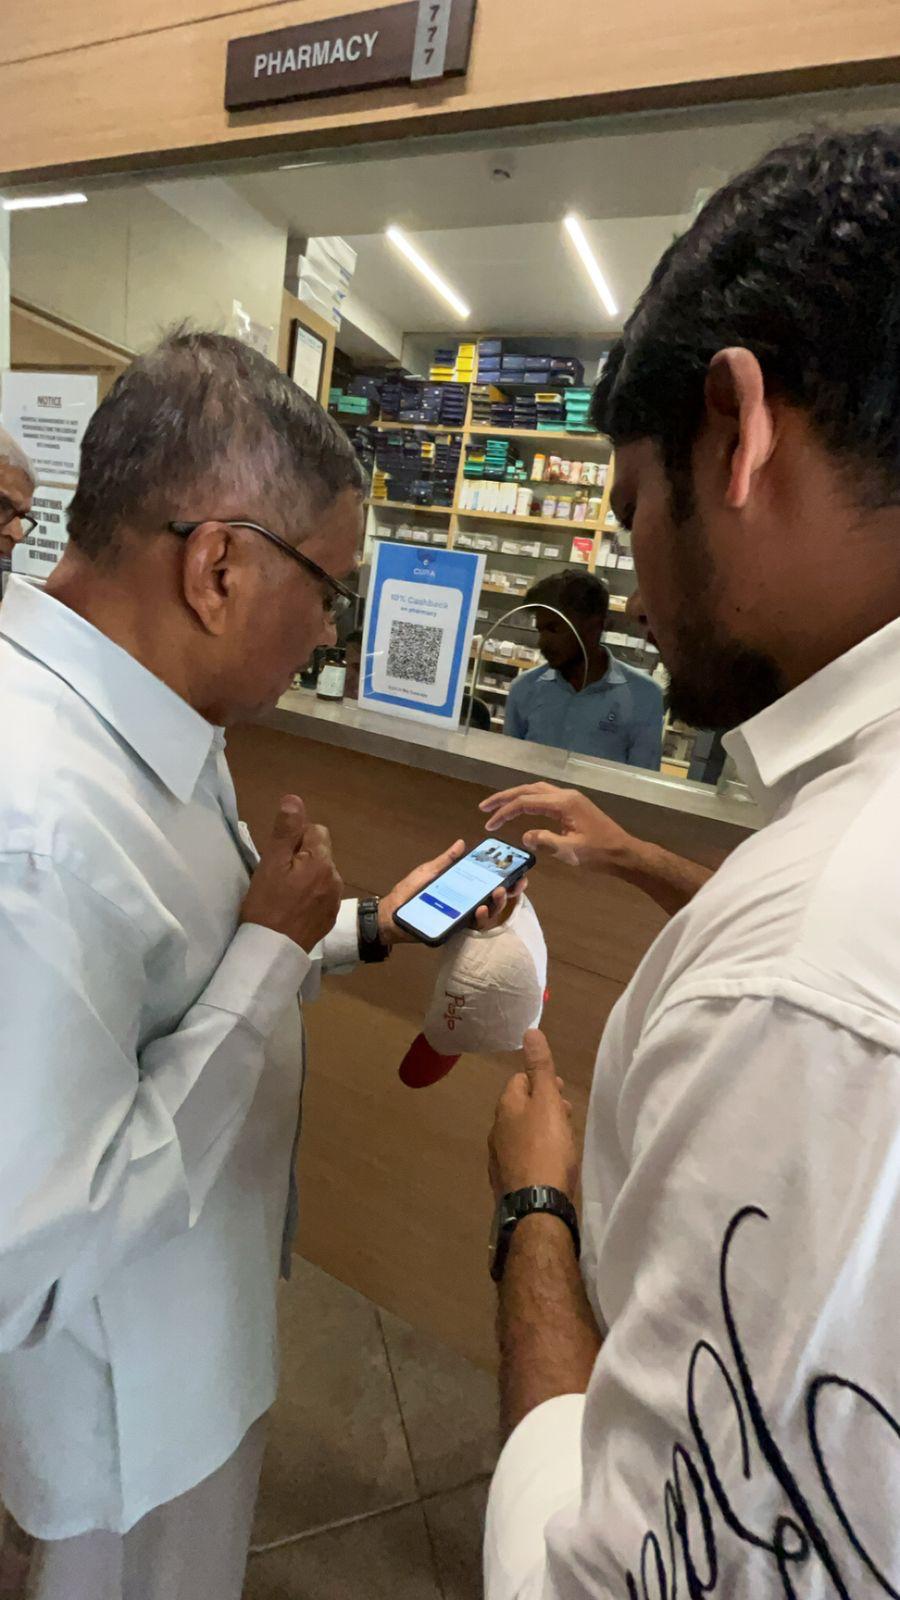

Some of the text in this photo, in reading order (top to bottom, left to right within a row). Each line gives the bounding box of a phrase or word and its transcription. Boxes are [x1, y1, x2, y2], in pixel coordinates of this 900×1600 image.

[253, 31, 379, 78] PHARMACY
[37, 396, 62, 407] NOTICE
[407, 596, 449, 609] Cashback
